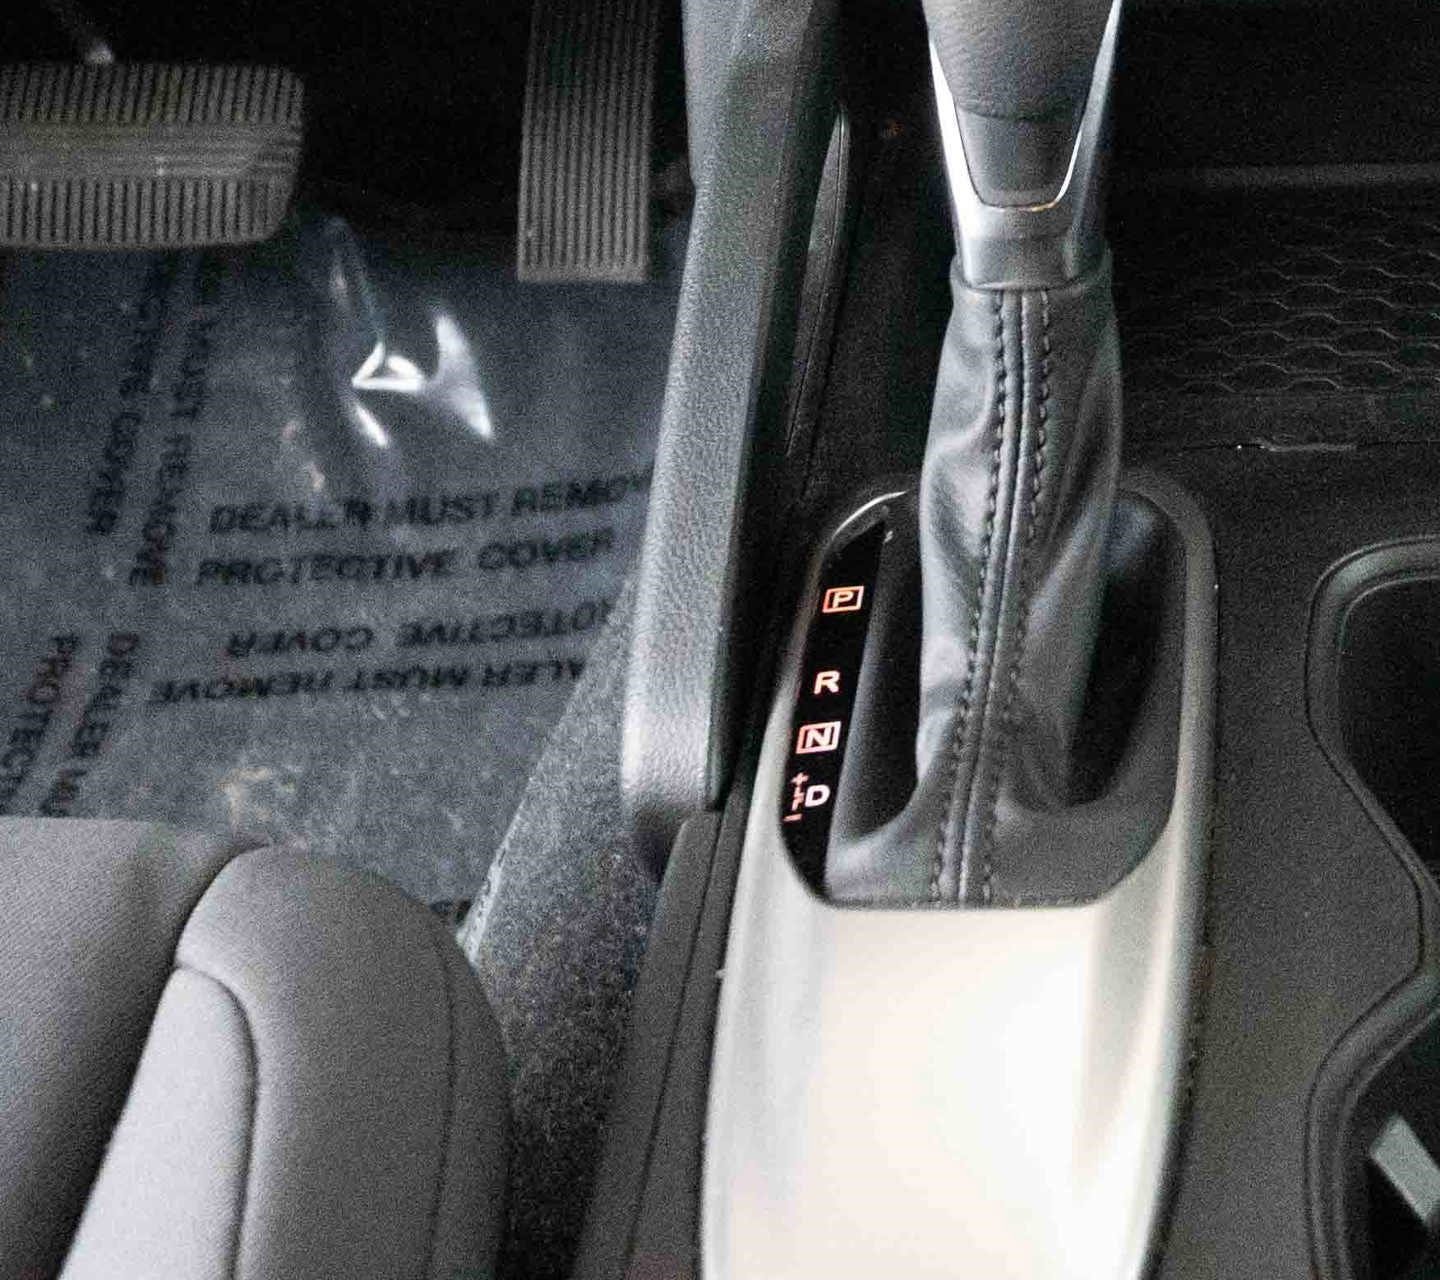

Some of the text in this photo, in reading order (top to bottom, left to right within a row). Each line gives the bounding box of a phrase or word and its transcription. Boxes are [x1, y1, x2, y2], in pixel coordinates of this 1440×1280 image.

[385, 490, 500, 525] MUST
[195, 527, 615, 585] PROTECTIVE COVER
[833, 591, 854, 609] P
[227, 627, 372, 657] COVER
[813, 670, 841, 695] R
[806, 728, 833, 747] N
[804, 784, 831, 807] D
